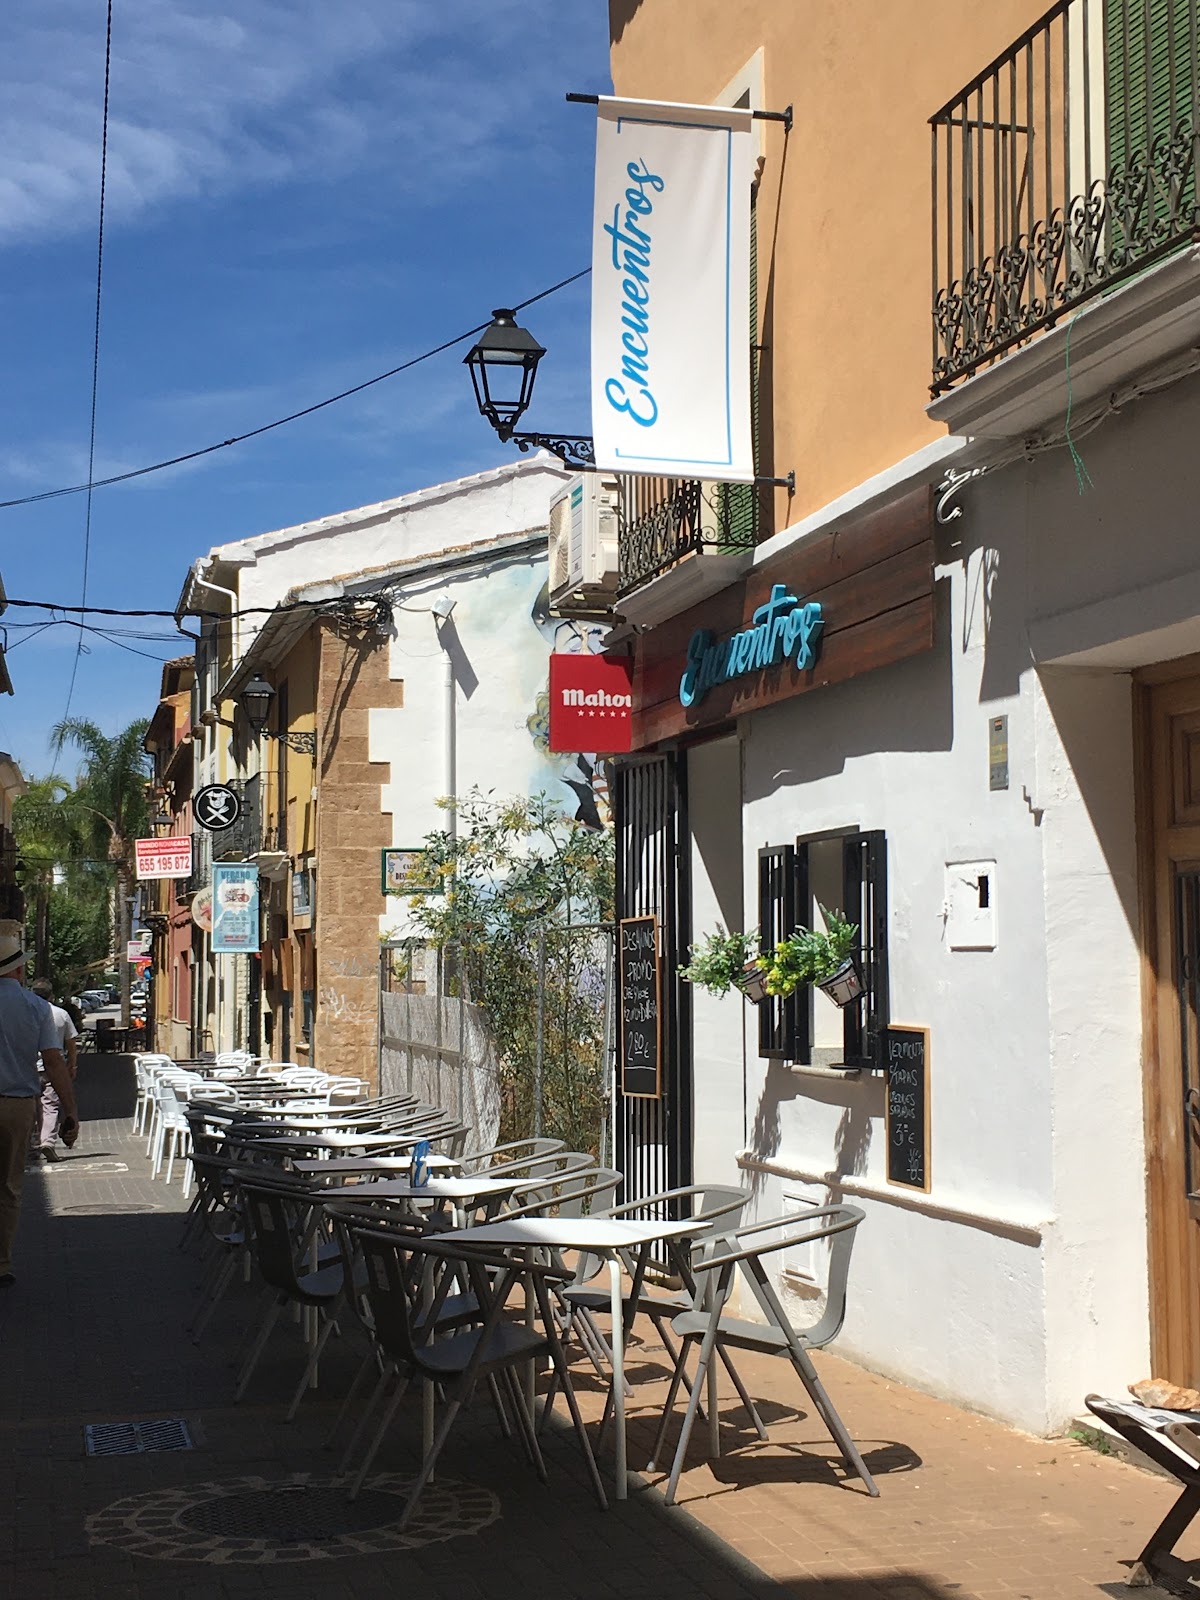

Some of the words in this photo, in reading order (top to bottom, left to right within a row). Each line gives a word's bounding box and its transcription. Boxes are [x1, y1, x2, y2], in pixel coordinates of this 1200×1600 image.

[603, 156, 665, 428] Encuentros
[679, 583, 826, 708] Encuentros
[139, 858, 155, 872] 655
[157, 856, 172, 871] 195
[174, 855, 190, 870] 872
